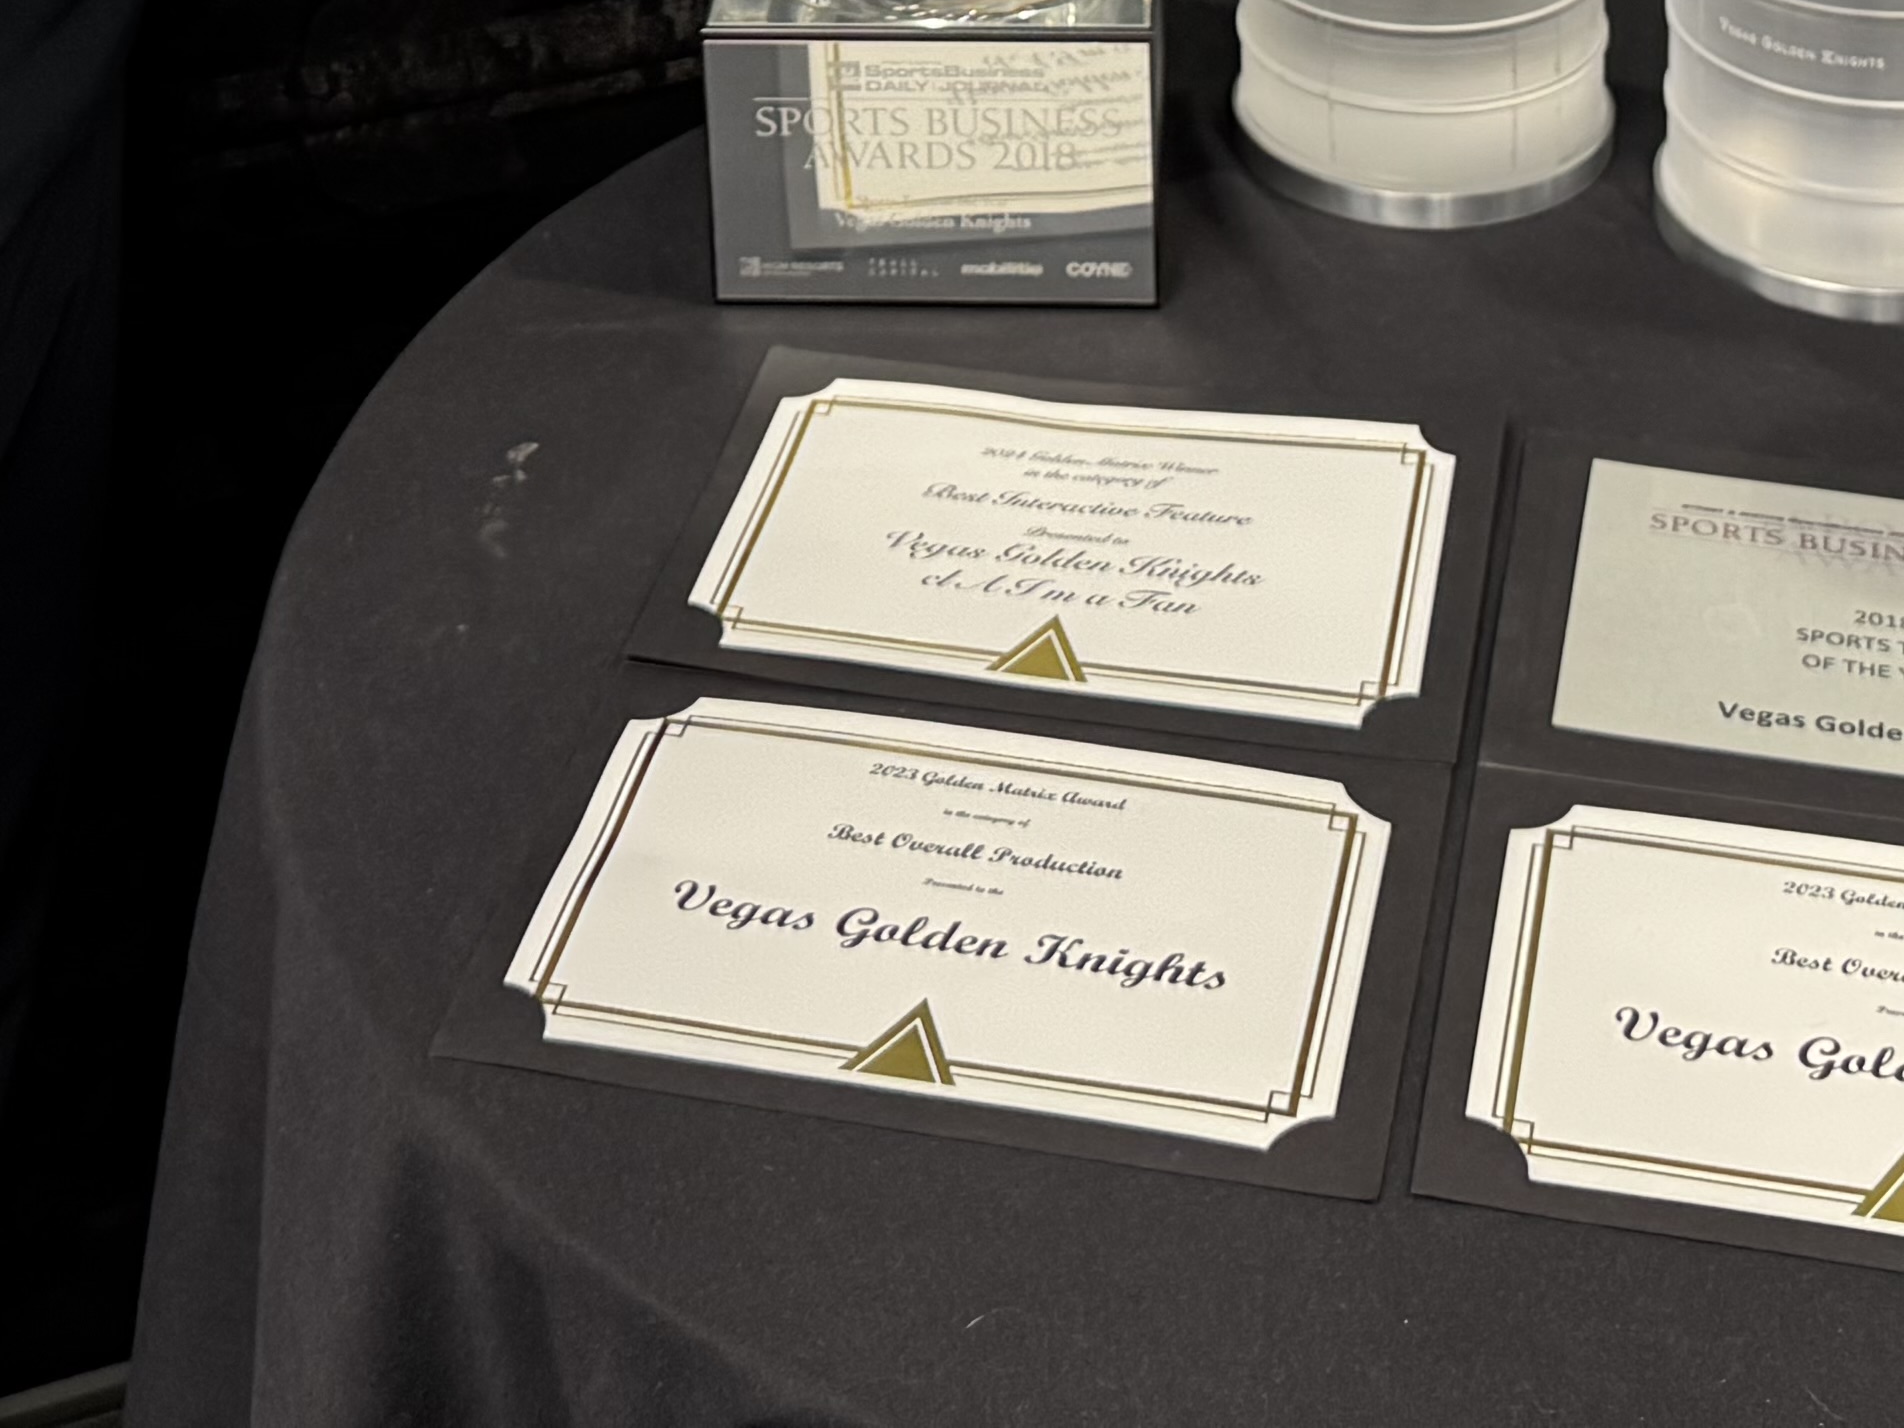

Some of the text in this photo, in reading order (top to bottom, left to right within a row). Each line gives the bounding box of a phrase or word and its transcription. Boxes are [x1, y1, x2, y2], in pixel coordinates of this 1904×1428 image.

[865, 64, 1044, 80] SportsBusiness
[865, 80, 929, 92] DAILY
[754, 107, 1122, 138] SPORTS BUSINESS
[804, 142, 1077, 171] AWARDS 2018
[960, 212, 1032, 233] Knights
[1043, 468, 1070, 481] the
[1072, 473, 1144, 488] category
[922, 483, 1254, 526] Best Interactive Feature
[1023, 525, 1112, 545] Presented
[1649, 512, 1786, 546] SPORTS
[886, 530, 1266, 588] Vegas Golden Knights
[1119, 589, 1202, 615] Fan
[1796, 627, 1891, 653] SPORTS
[1801, 654, 1836, 670] OF
[1843, 658, 1891, 679] THE
[1718, 700, 1806, 728] Vegas
[869, 762, 1127, 811] 2023 Golden Matrix Award
[828, 823, 1124, 880] Best Overall Production
[1783, 880, 1835, 900] 2023
[673, 879, 1228, 991] Vegas Golden Knights
[1771, 947, 1833, 972] Best
[1614, 1005, 1775, 1063] Vegas
